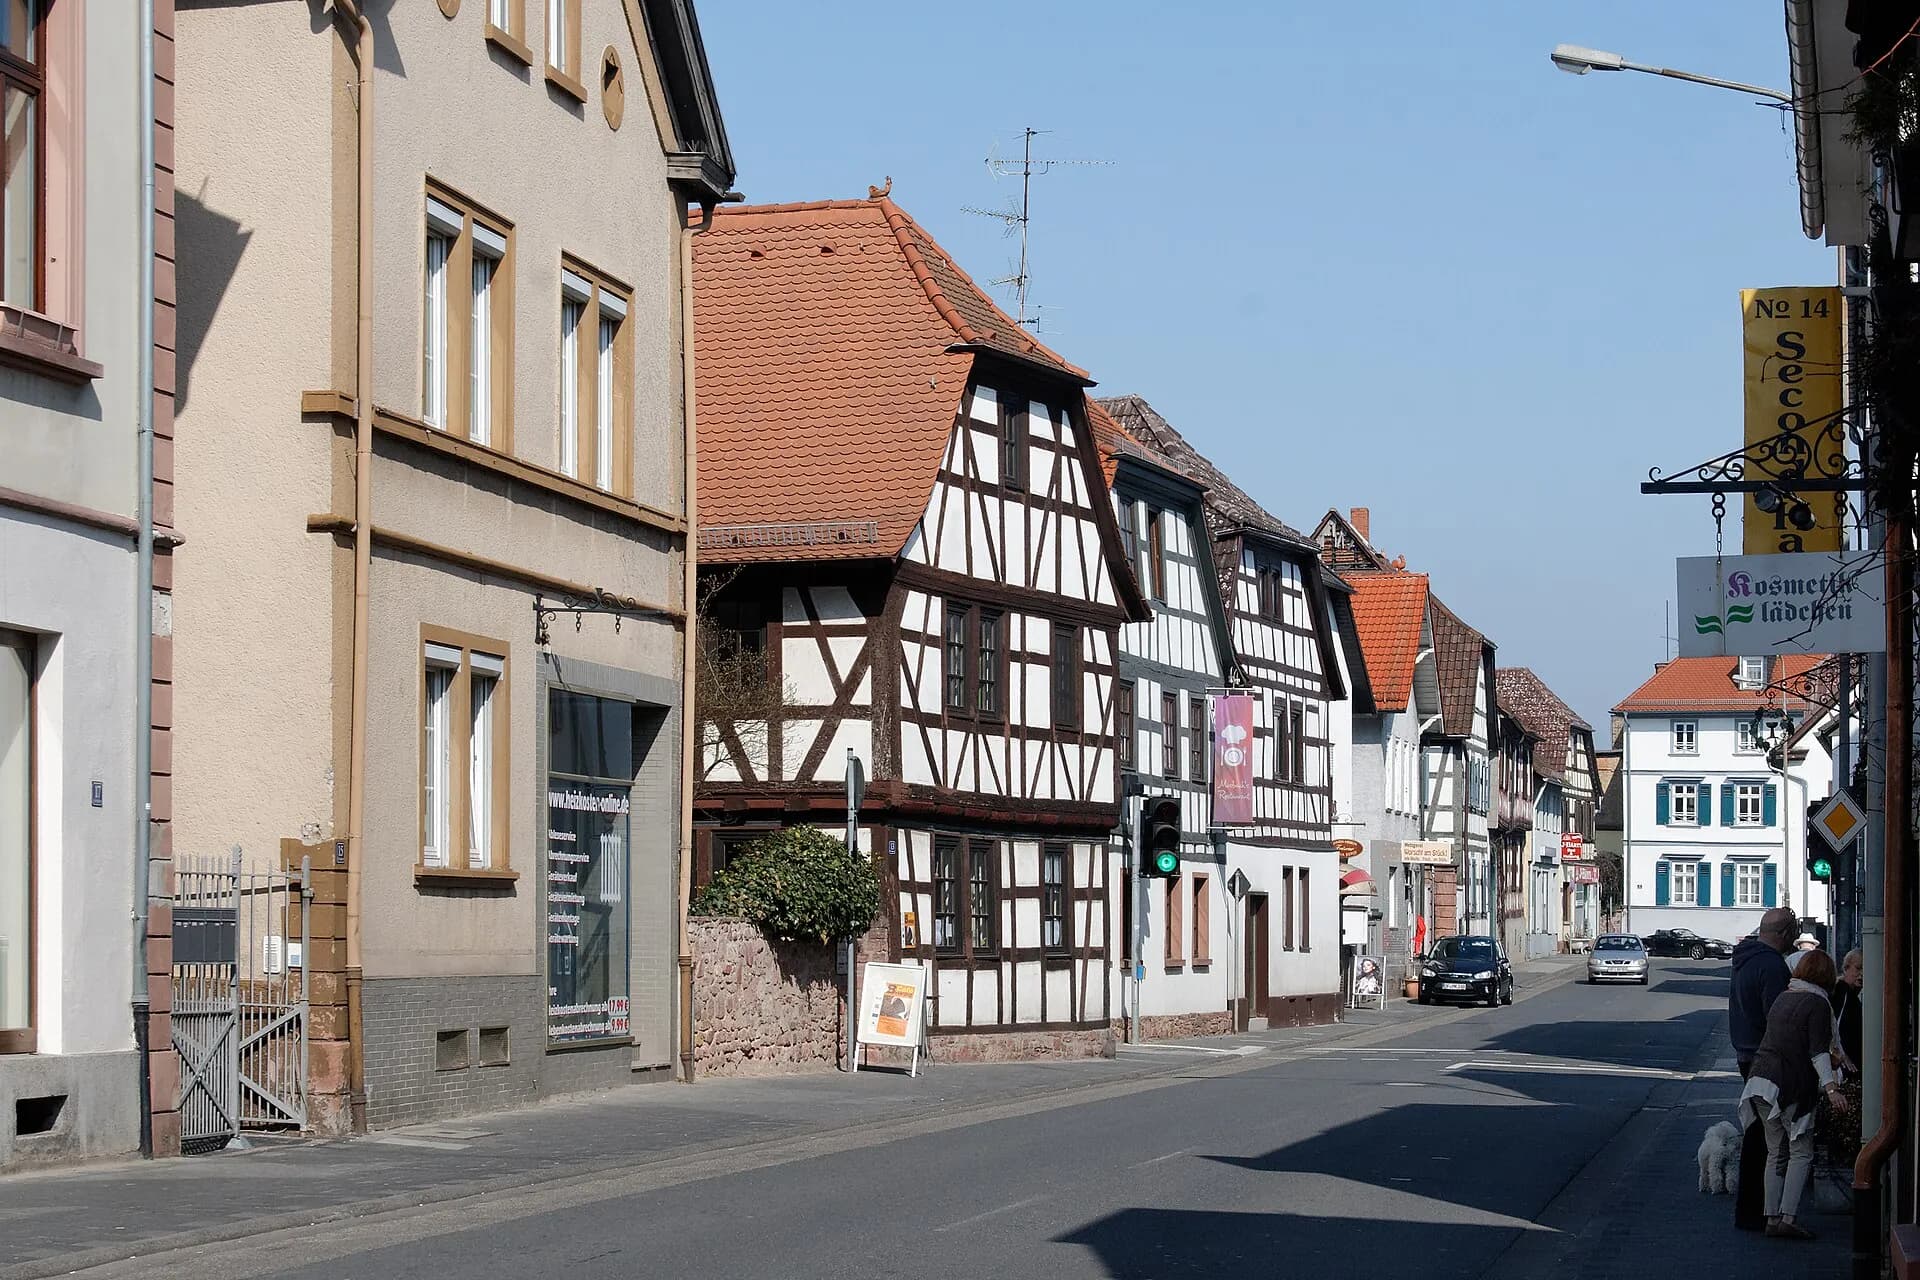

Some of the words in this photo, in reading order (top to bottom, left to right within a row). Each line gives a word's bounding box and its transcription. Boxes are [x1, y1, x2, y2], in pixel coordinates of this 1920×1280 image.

[1800, 299, 1829, 318] 14
[1728, 570, 1854, 598] Kosmetik
[609, 999, 623, 1013] 17,99
[611, 1019, 624, 1032] 9,99
